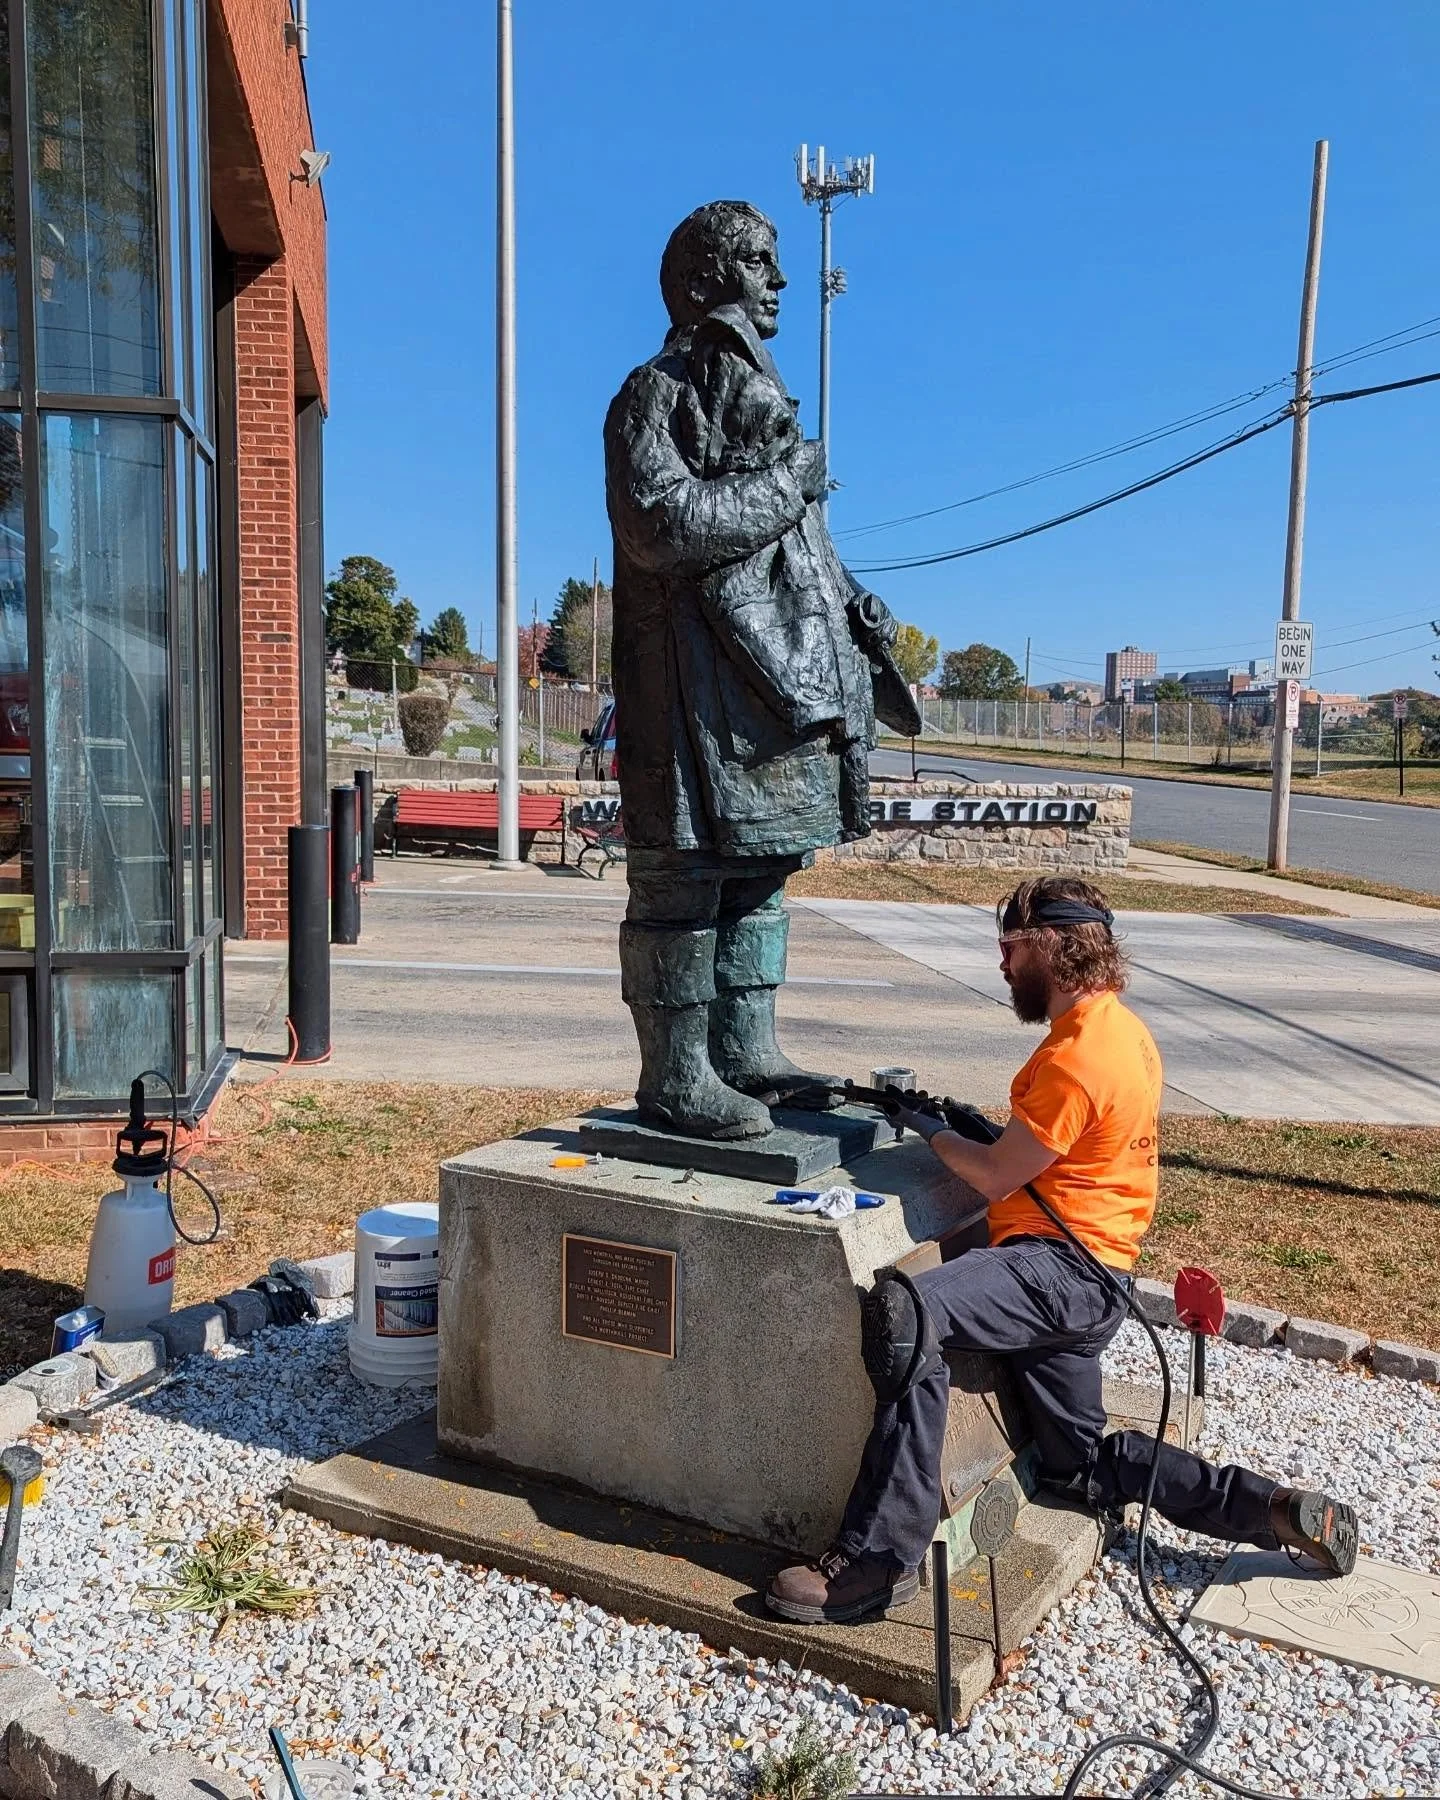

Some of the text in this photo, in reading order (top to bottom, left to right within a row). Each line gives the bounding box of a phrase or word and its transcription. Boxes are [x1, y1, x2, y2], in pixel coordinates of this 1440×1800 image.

[1279, 627, 1311, 640] BEGIN
[1281, 645, 1306, 658] ONE
[1281, 662, 1305, 675] WAY
[583, 800, 1097, 821] W RE STATION
